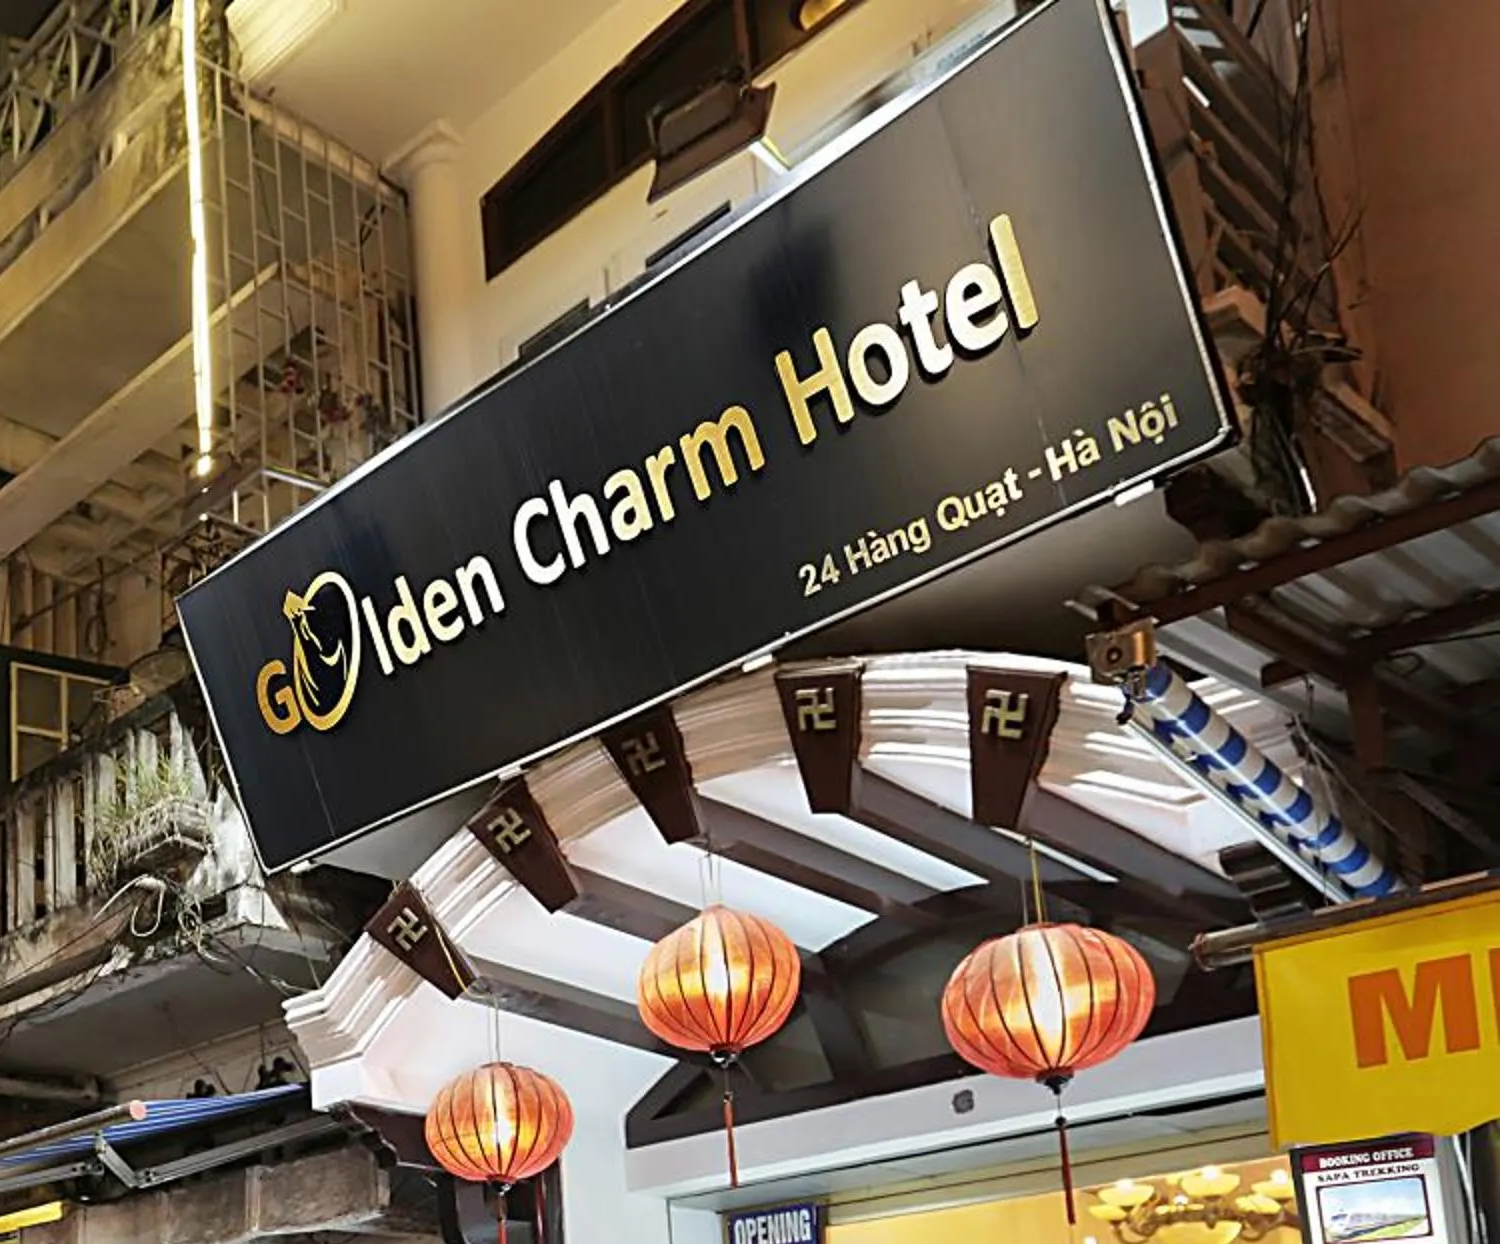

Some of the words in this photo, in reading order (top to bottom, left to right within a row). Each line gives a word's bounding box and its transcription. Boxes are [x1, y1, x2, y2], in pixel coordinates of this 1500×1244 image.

[513, 405, 765, 585] Charm
[775, 214, 1039, 445] Hotel
[799, 553, 840, 597] 24
[843, 517, 932, 575] Hàng
[937, 467, 1023, 532] Quạt
[1044, 429, 1101, 481] Hà
[1107, 393, 1180, 453] Nội
[1348, 948, 1500, 1070] M
[1318, 1152, 1370, 1169] BOOKING
[1372, 1147, 1414, 1162] OFFICE
[1318, 1171, 1350, 1182] SAPA
[1353, 1163, 1420, 1178] TREKKING
